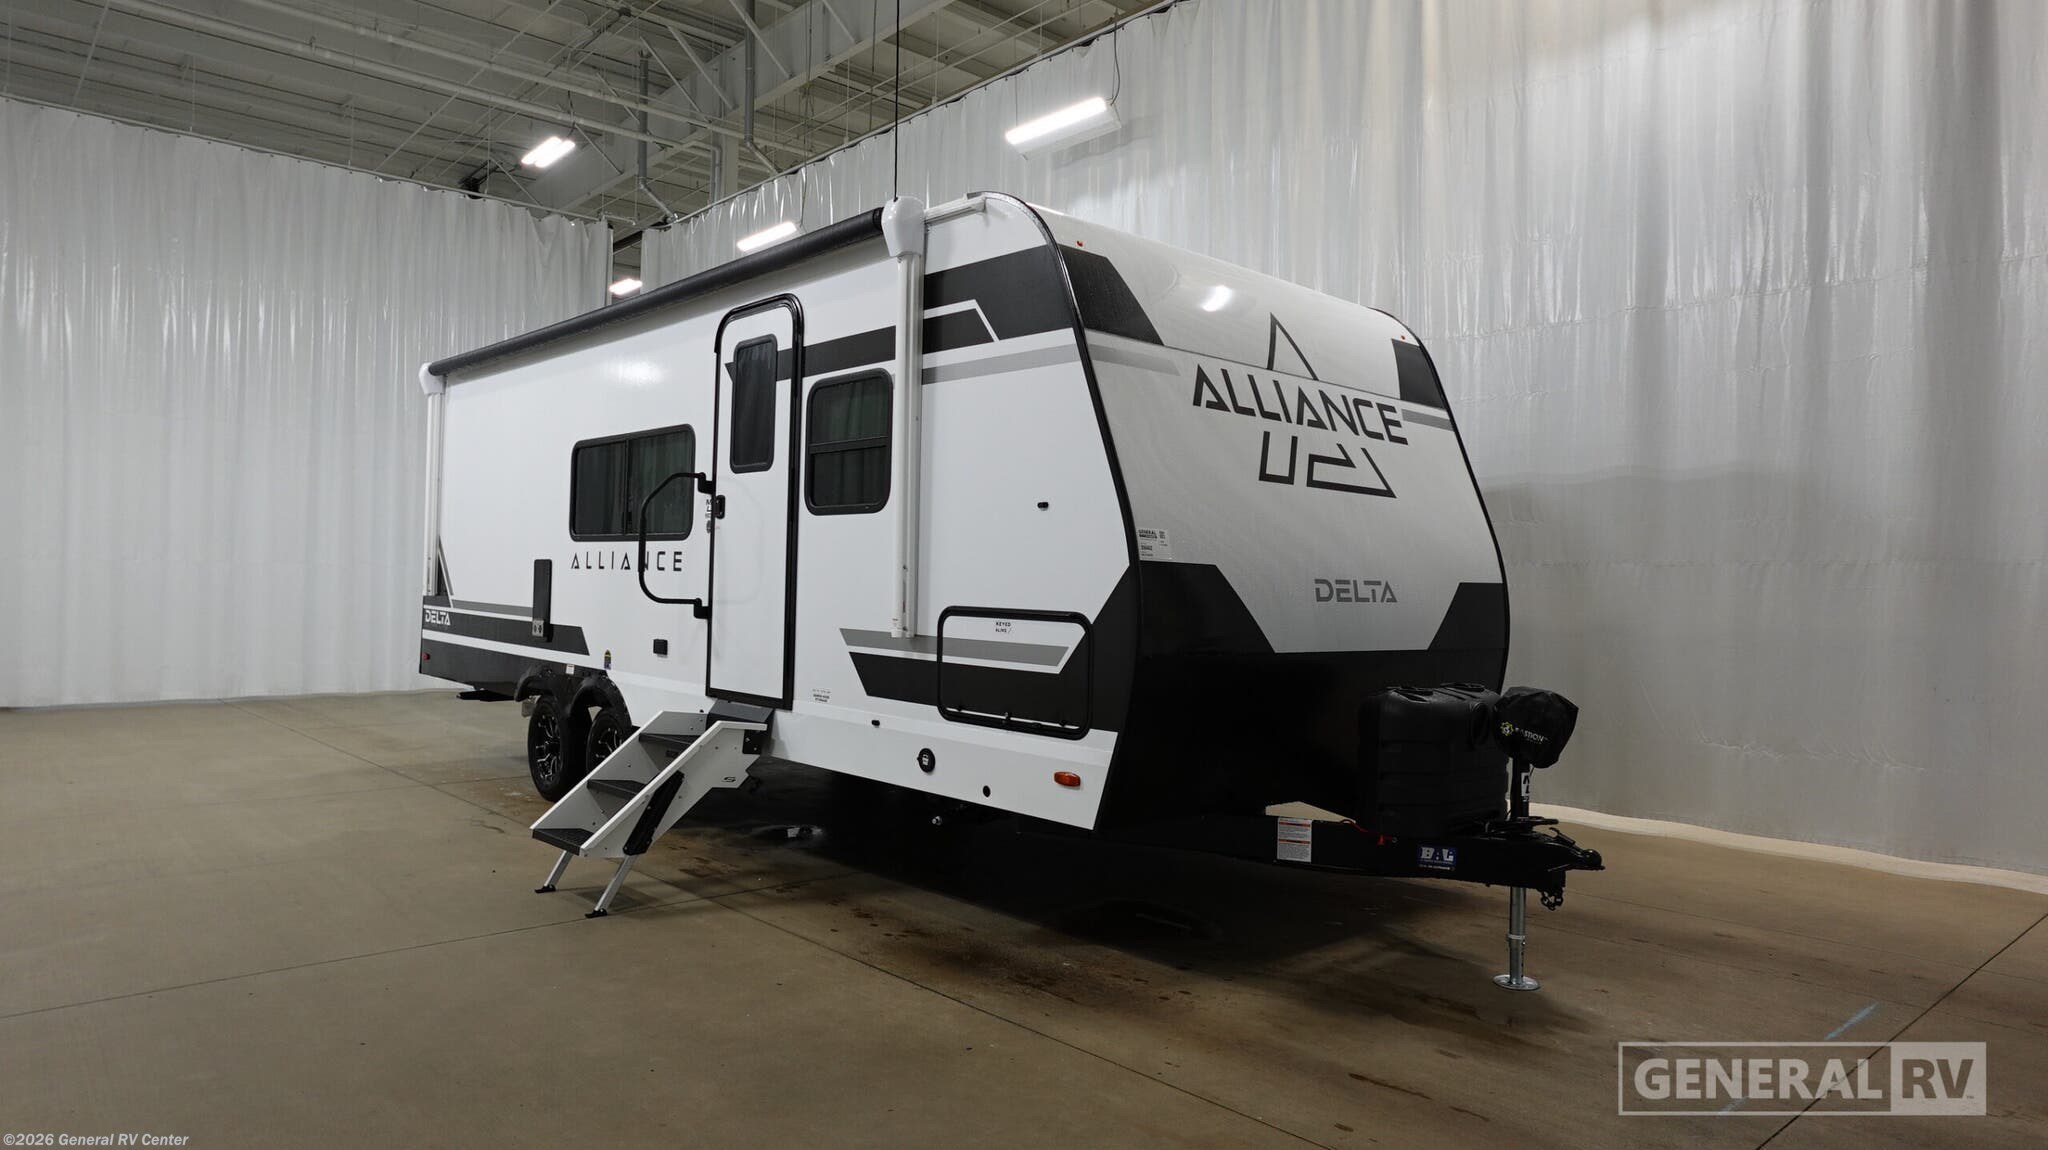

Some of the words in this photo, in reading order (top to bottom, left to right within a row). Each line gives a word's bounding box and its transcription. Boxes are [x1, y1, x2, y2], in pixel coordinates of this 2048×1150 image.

[1193, 364, 1409, 445] ALLIANCE
[1314, 578, 1398, 603] DELTA
[425, 610, 450, 625] DELTA
